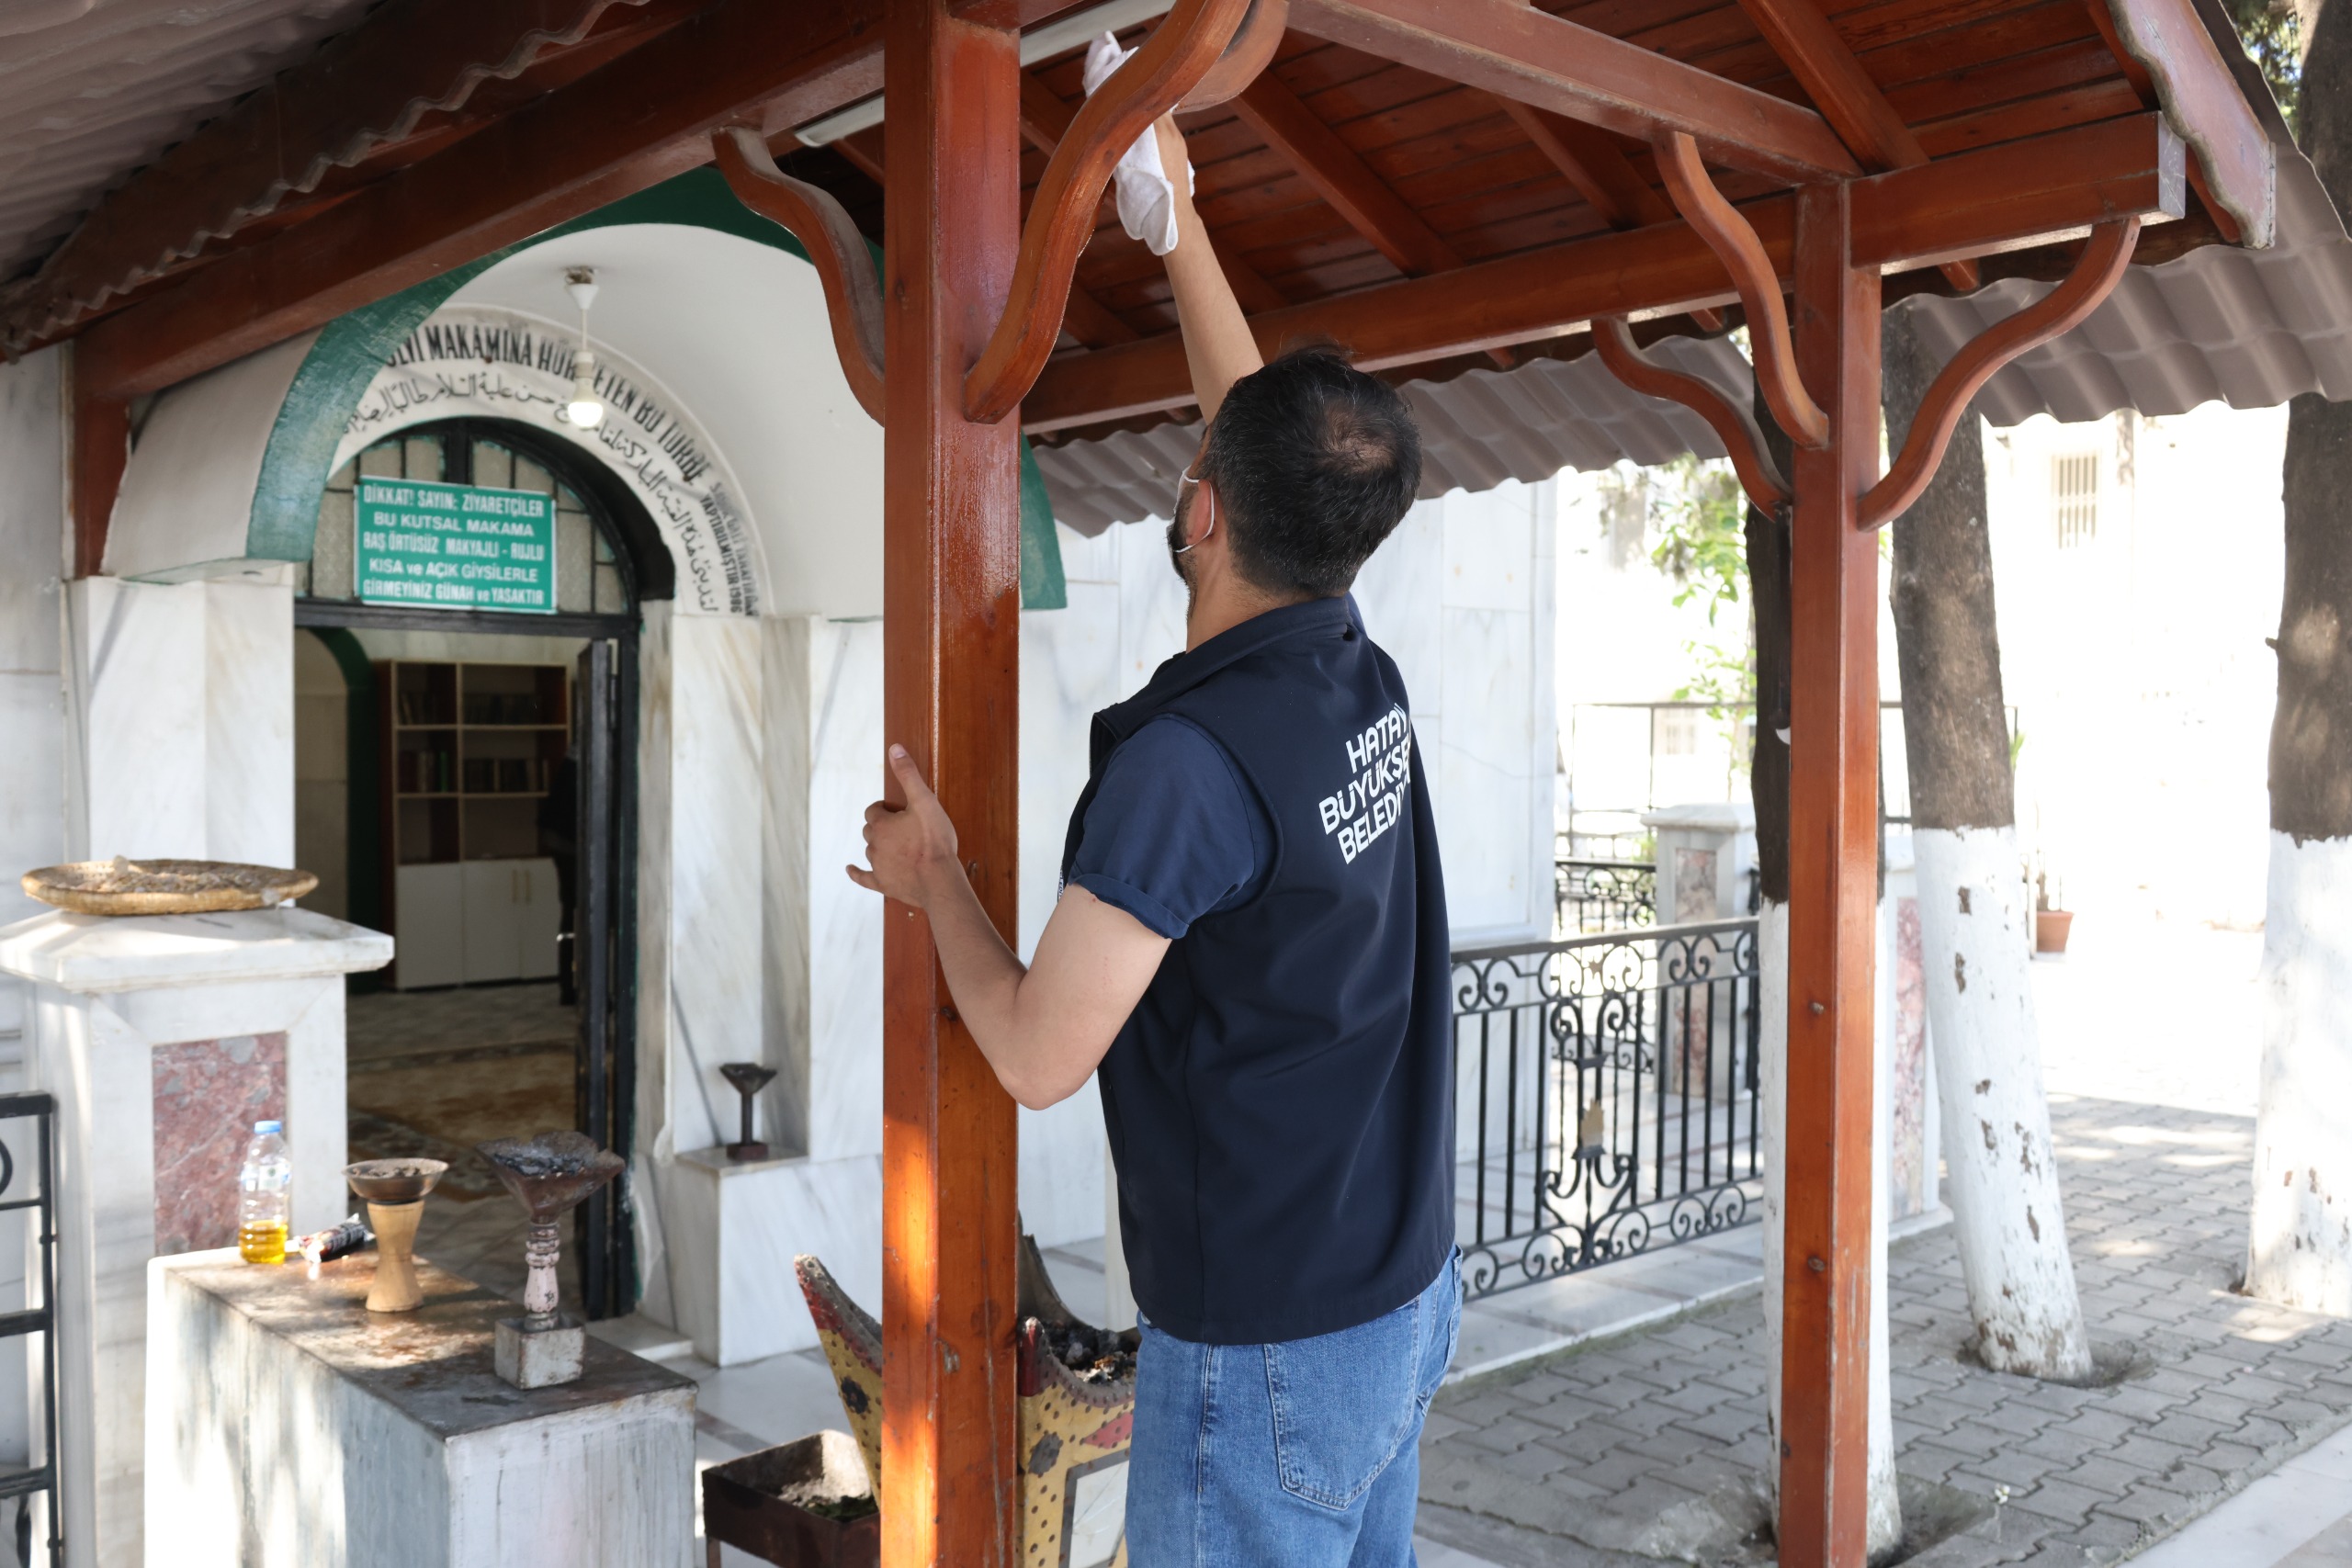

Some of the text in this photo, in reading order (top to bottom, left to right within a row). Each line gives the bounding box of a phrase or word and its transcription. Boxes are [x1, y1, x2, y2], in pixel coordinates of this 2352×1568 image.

[424, 323, 532, 367] MAKAMINA
[632, 397, 665, 434] BU
[461, 491, 544, 517] ZİYARETÇİLER
[374, 511, 534, 537] BU KUTSAL MAKAMA
[364, 531, 386, 553] BAŞ
[389, 530, 439, 554] ÖRTÜSÜZ
[446, 537, 499, 558] MAKYAJLI
[511, 542, 544, 561] RUJLU
[369, 558, 537, 582] KISA ve AÇIK GİYSİLERLE
[363, 577, 544, 605] GİRMEYİNİZ GÜNAH ve YASAKTIR
[1345, 702, 1408, 773] HATAY
